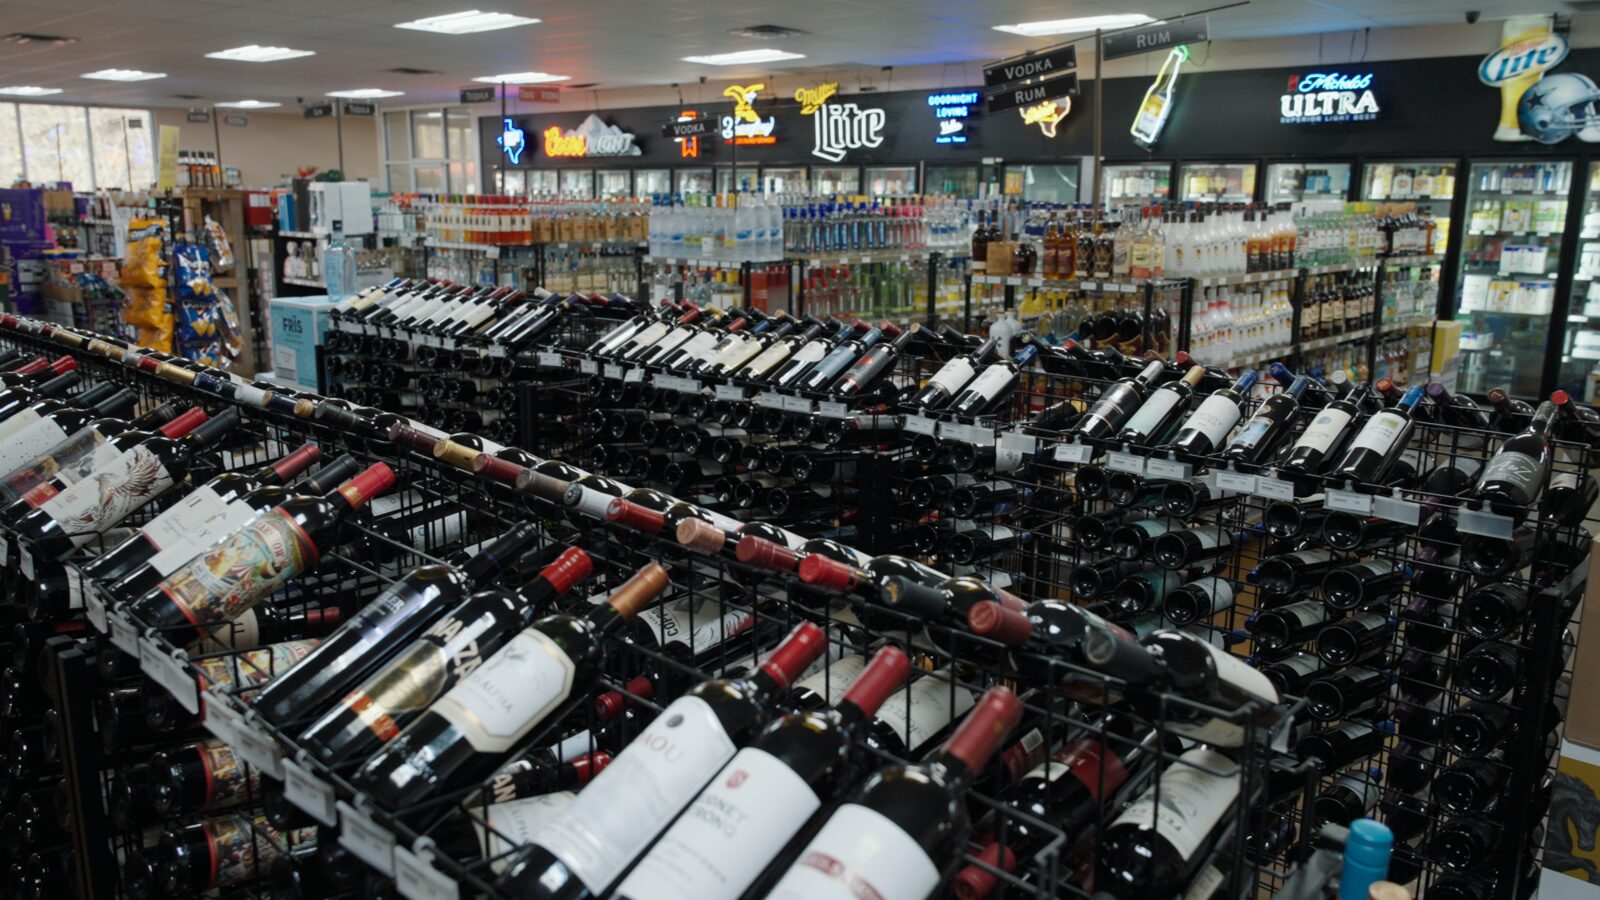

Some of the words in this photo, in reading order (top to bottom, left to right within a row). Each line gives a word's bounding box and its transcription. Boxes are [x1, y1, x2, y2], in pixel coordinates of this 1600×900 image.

[1136, 31, 1171, 49] RUM
[1004, 58, 1053, 80] VODKA
[1298, 72, 1374, 93] Michelob
[928, 92, 978, 106] GOODNIGHT
[1014, 87, 1046, 104] RUM
[1280, 89, 1380, 118] ULTRA
[674, 122, 705, 135] VODKA
[812, 103, 886, 162] Lite
